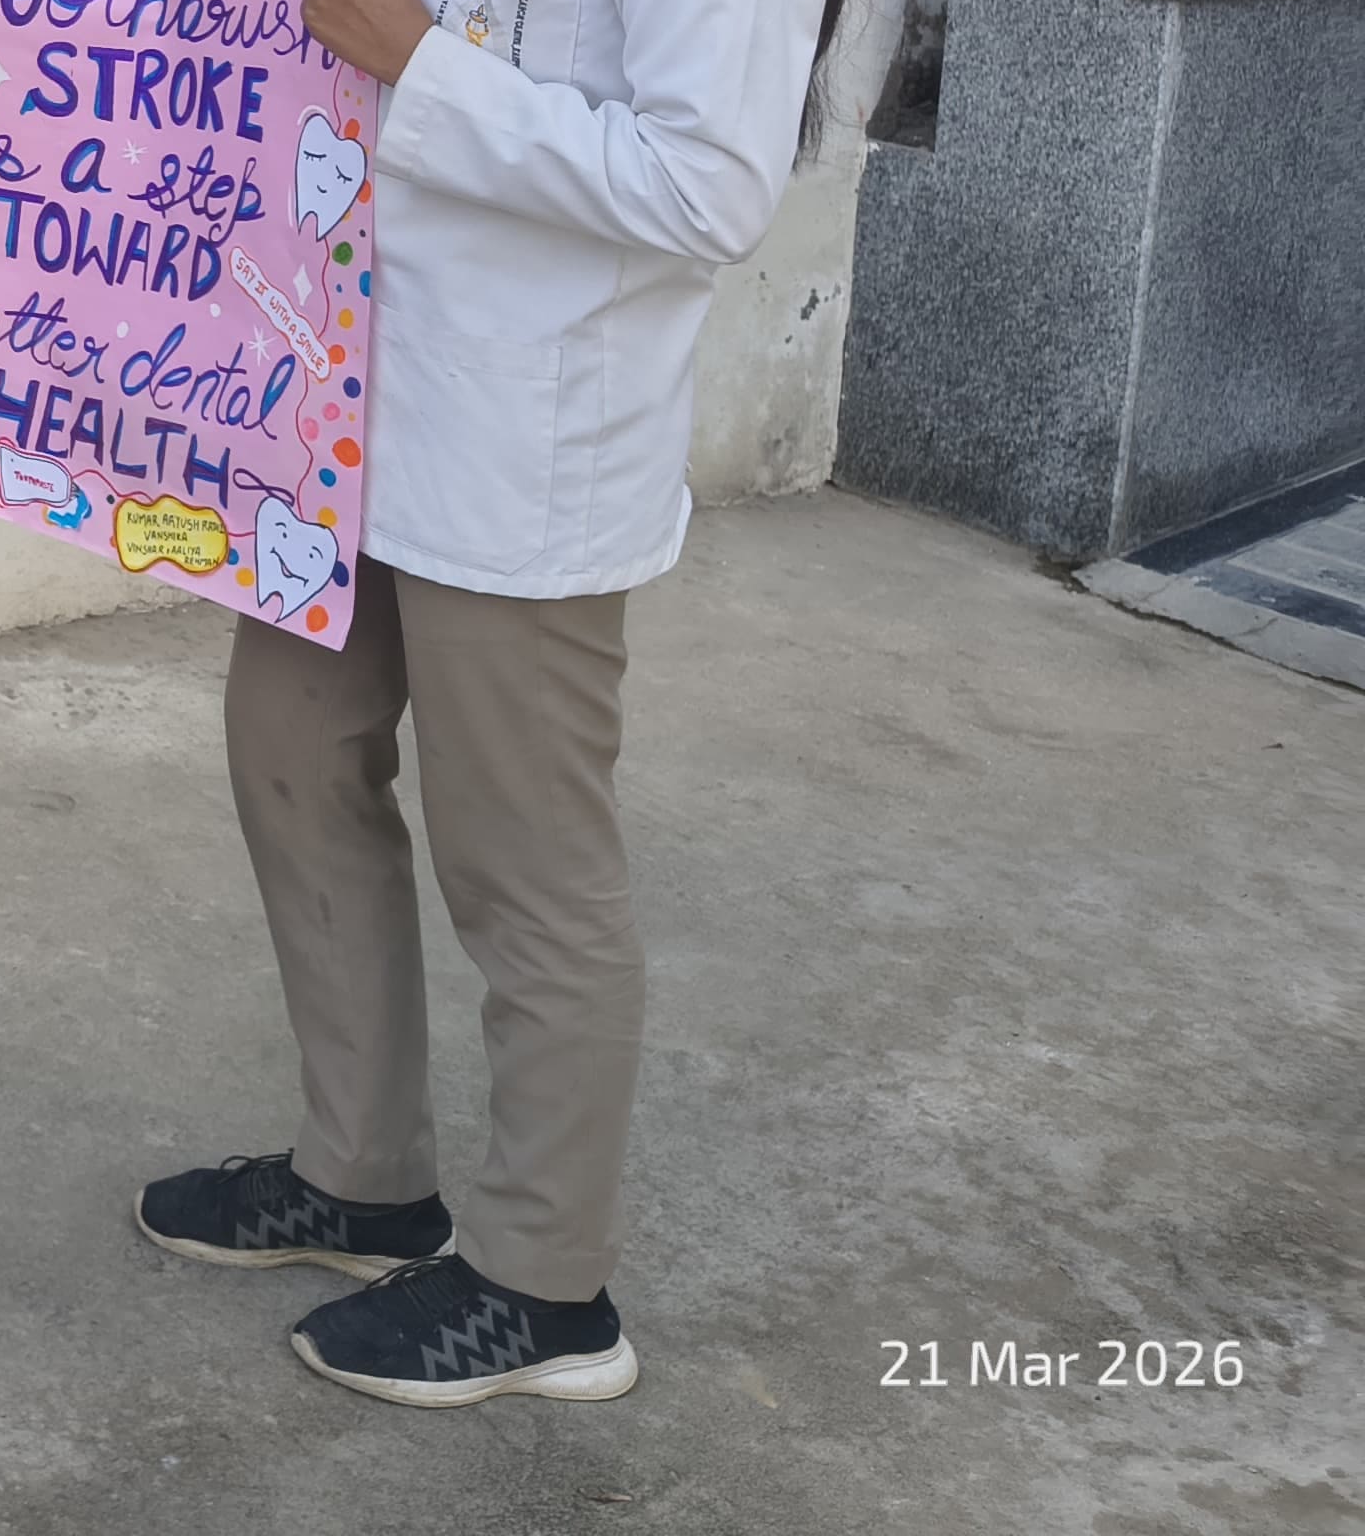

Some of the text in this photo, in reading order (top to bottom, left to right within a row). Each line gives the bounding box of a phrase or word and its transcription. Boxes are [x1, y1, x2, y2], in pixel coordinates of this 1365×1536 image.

[20, 41, 268, 142] STROKE
[60, 137, 112, 192] a
[127, 145, 266, 243] step
[235, 256, 256, 283] SAY
[269, 296, 291, 325] WITH
[288, 324, 297, 336] A
[295, 332, 326, 371] SMILE
[119, 322, 296, 440] dental
